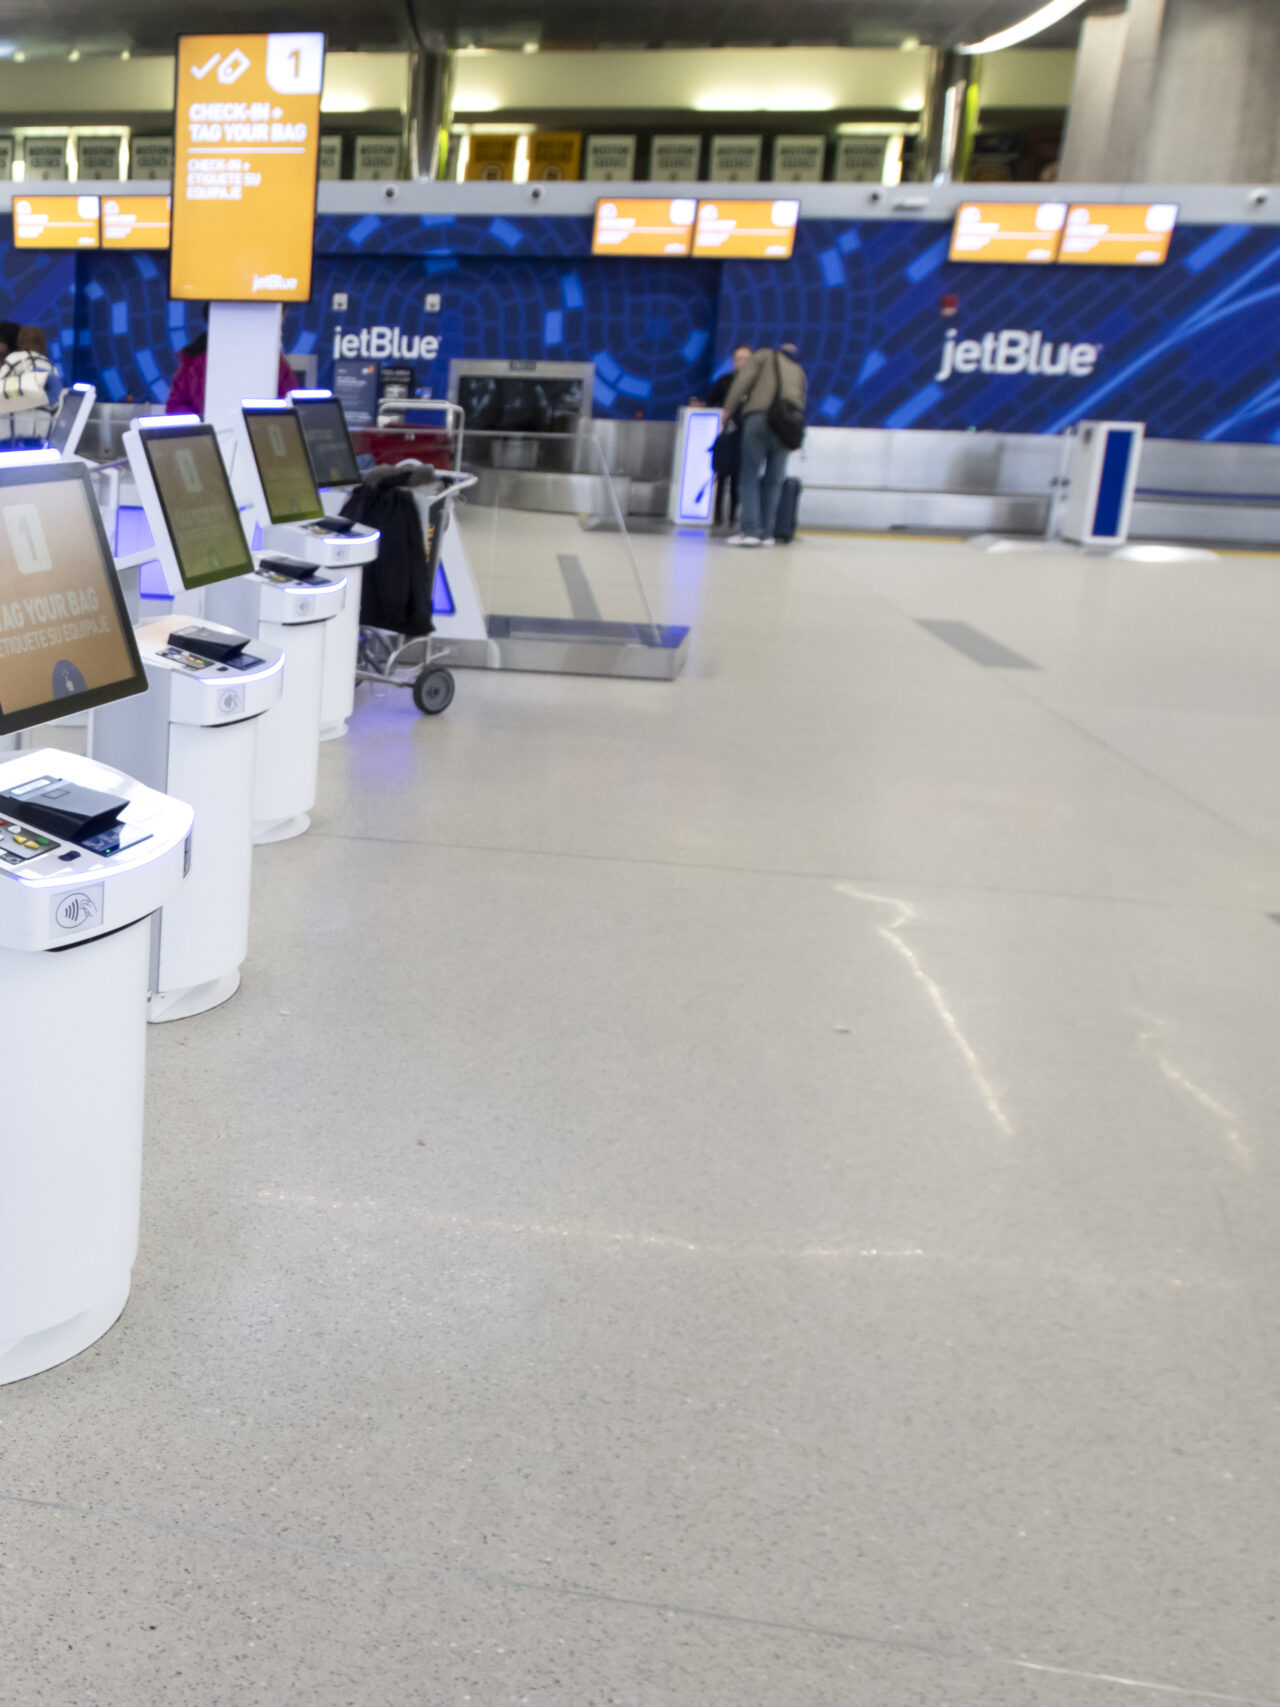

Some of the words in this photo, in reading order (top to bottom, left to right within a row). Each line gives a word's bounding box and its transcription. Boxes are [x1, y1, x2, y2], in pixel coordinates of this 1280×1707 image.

[288, 49, 302, 78] 1
[189, 103, 270, 121] CHECK-IN
[189, 124, 222, 142] TAG
[223, 124, 268, 142] YOUR
[270, 123, 307, 142] BAG
[187, 159, 241, 171] CHECK-IN
[243, 173, 261, 186] SU
[252, 274, 298, 292] jetBlue
[333, 326, 440, 360] jetBlue
[934, 328, 1100, 381] jetBlue
[23, 593, 69, 625] YOUR
[67, 586, 100, 616] BAG
[47, 627, 63, 646] SU
